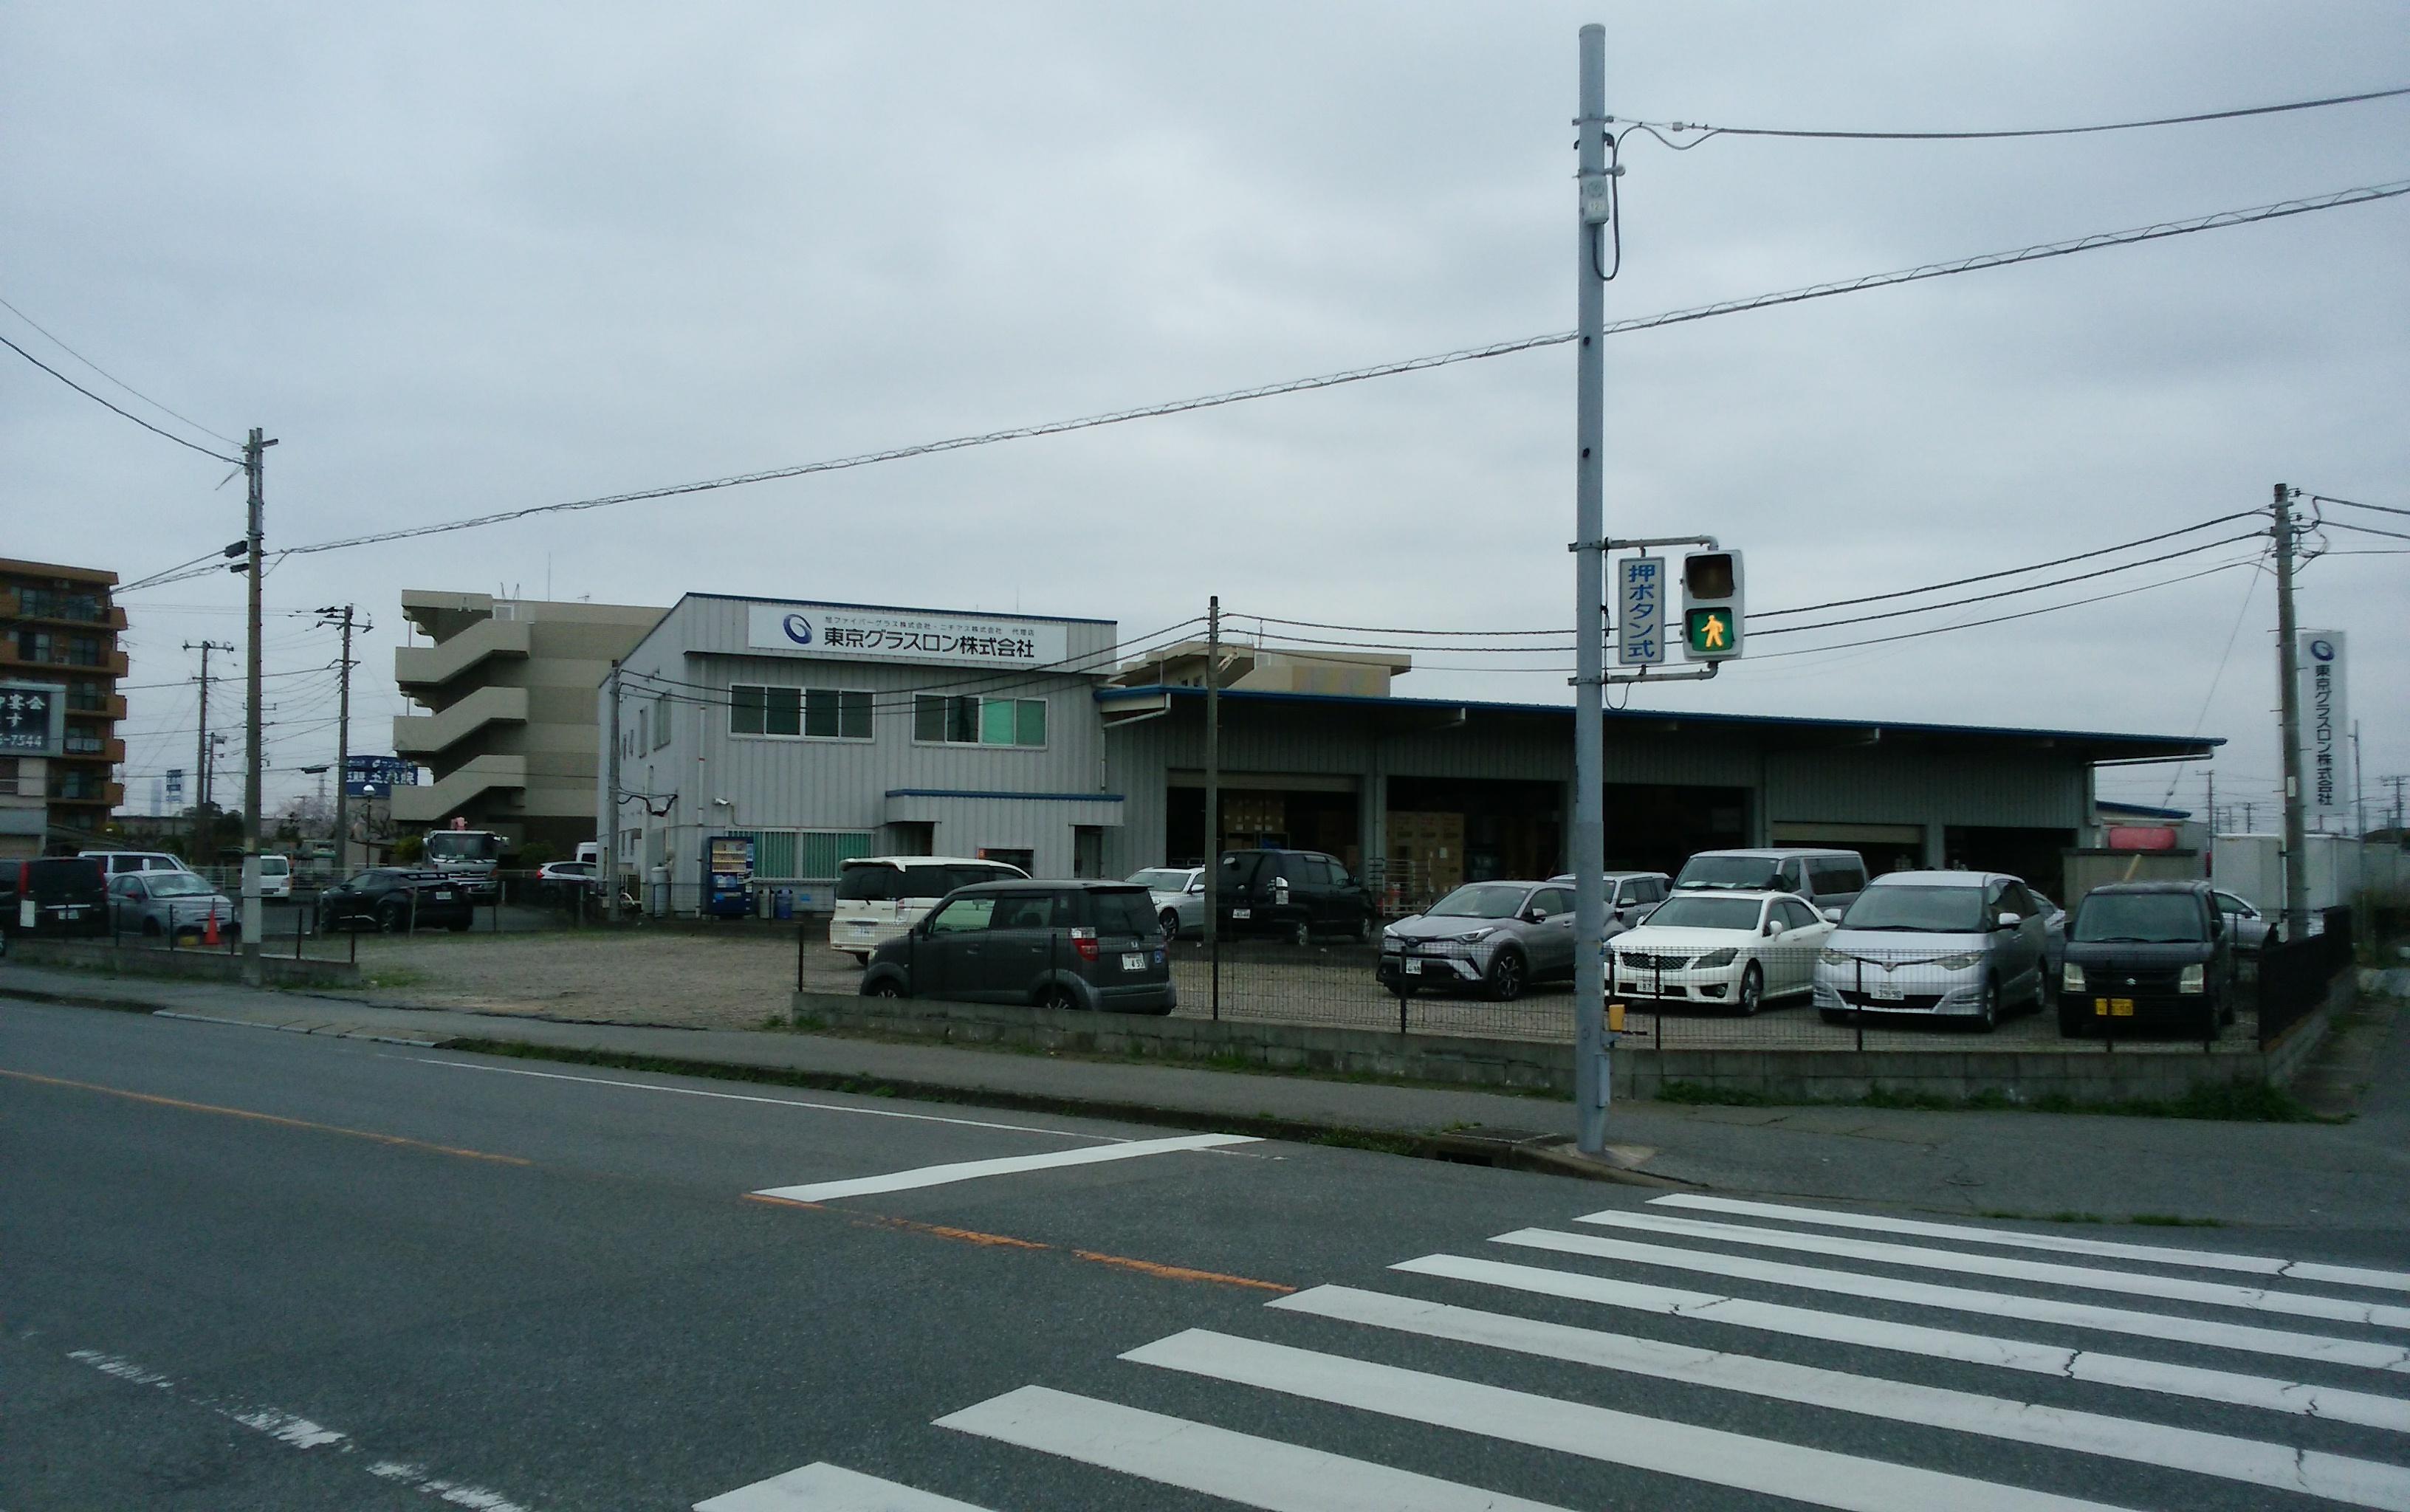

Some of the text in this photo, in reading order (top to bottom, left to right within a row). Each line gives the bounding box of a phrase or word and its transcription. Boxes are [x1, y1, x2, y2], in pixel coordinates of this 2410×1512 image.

[824, 627, 1034, 658] 東京グラスロン株式会社
[1628, 564, 1655, 658] 押ボタン式
[2315, 664, 2333, 806] 東京グラスロン株式会社
